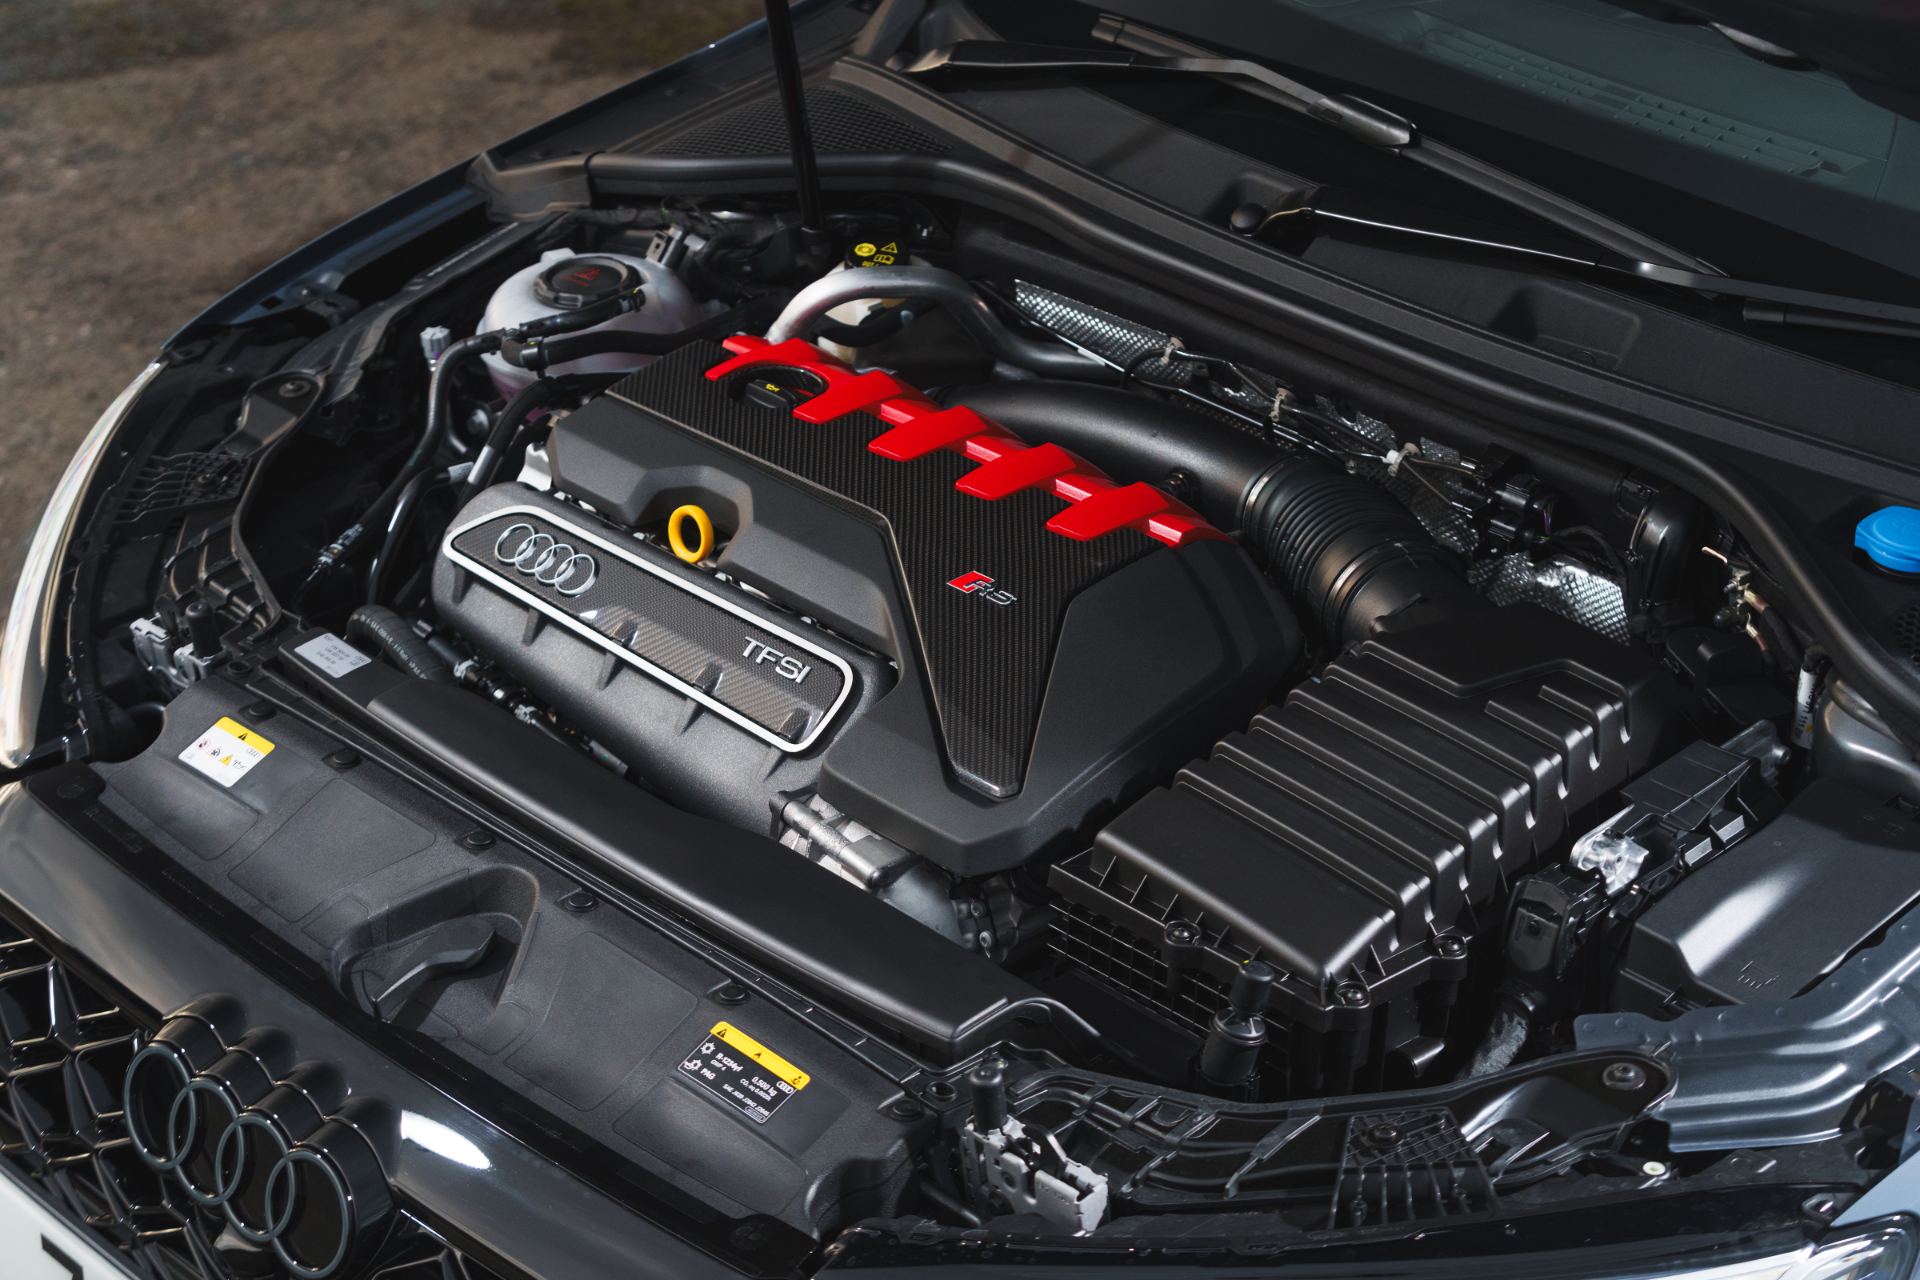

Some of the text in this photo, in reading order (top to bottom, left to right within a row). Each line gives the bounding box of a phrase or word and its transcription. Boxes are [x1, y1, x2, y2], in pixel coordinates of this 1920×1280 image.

[961, 579, 1017, 605] RS
[742, 636, 812, 684] TFSI
[715, 1053, 743, 1072] R-1234yf
[700, 1068, 716, 1080] PAG
[768, 1087, 778, 1096] kg
